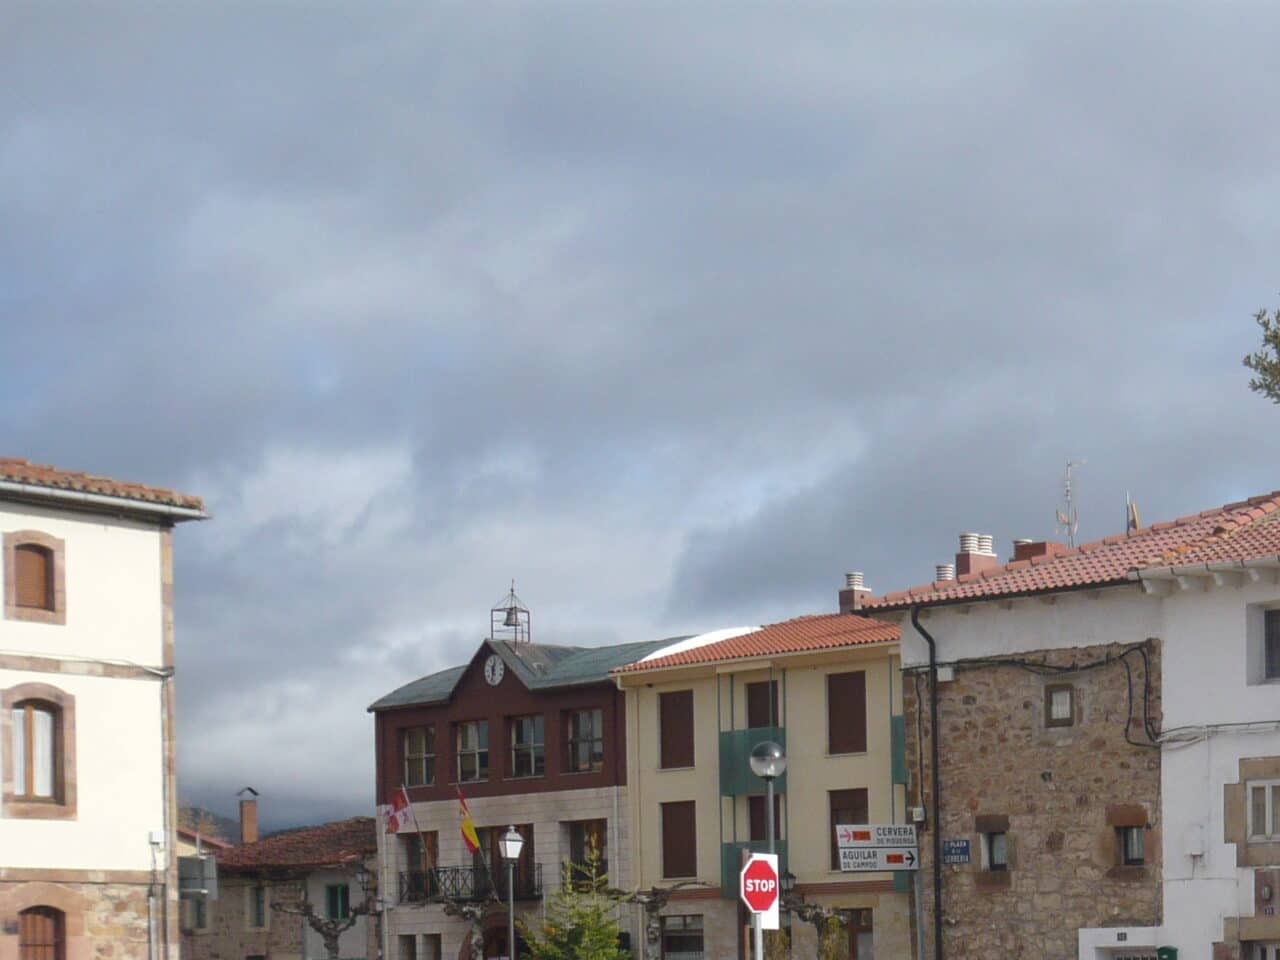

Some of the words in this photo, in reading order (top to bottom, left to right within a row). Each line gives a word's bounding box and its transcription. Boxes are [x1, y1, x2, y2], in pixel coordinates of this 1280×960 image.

[876, 827, 913, 837] CERVERA
[842, 850, 878, 860] AGUILAR
[746, 879, 775, 892] STOP
